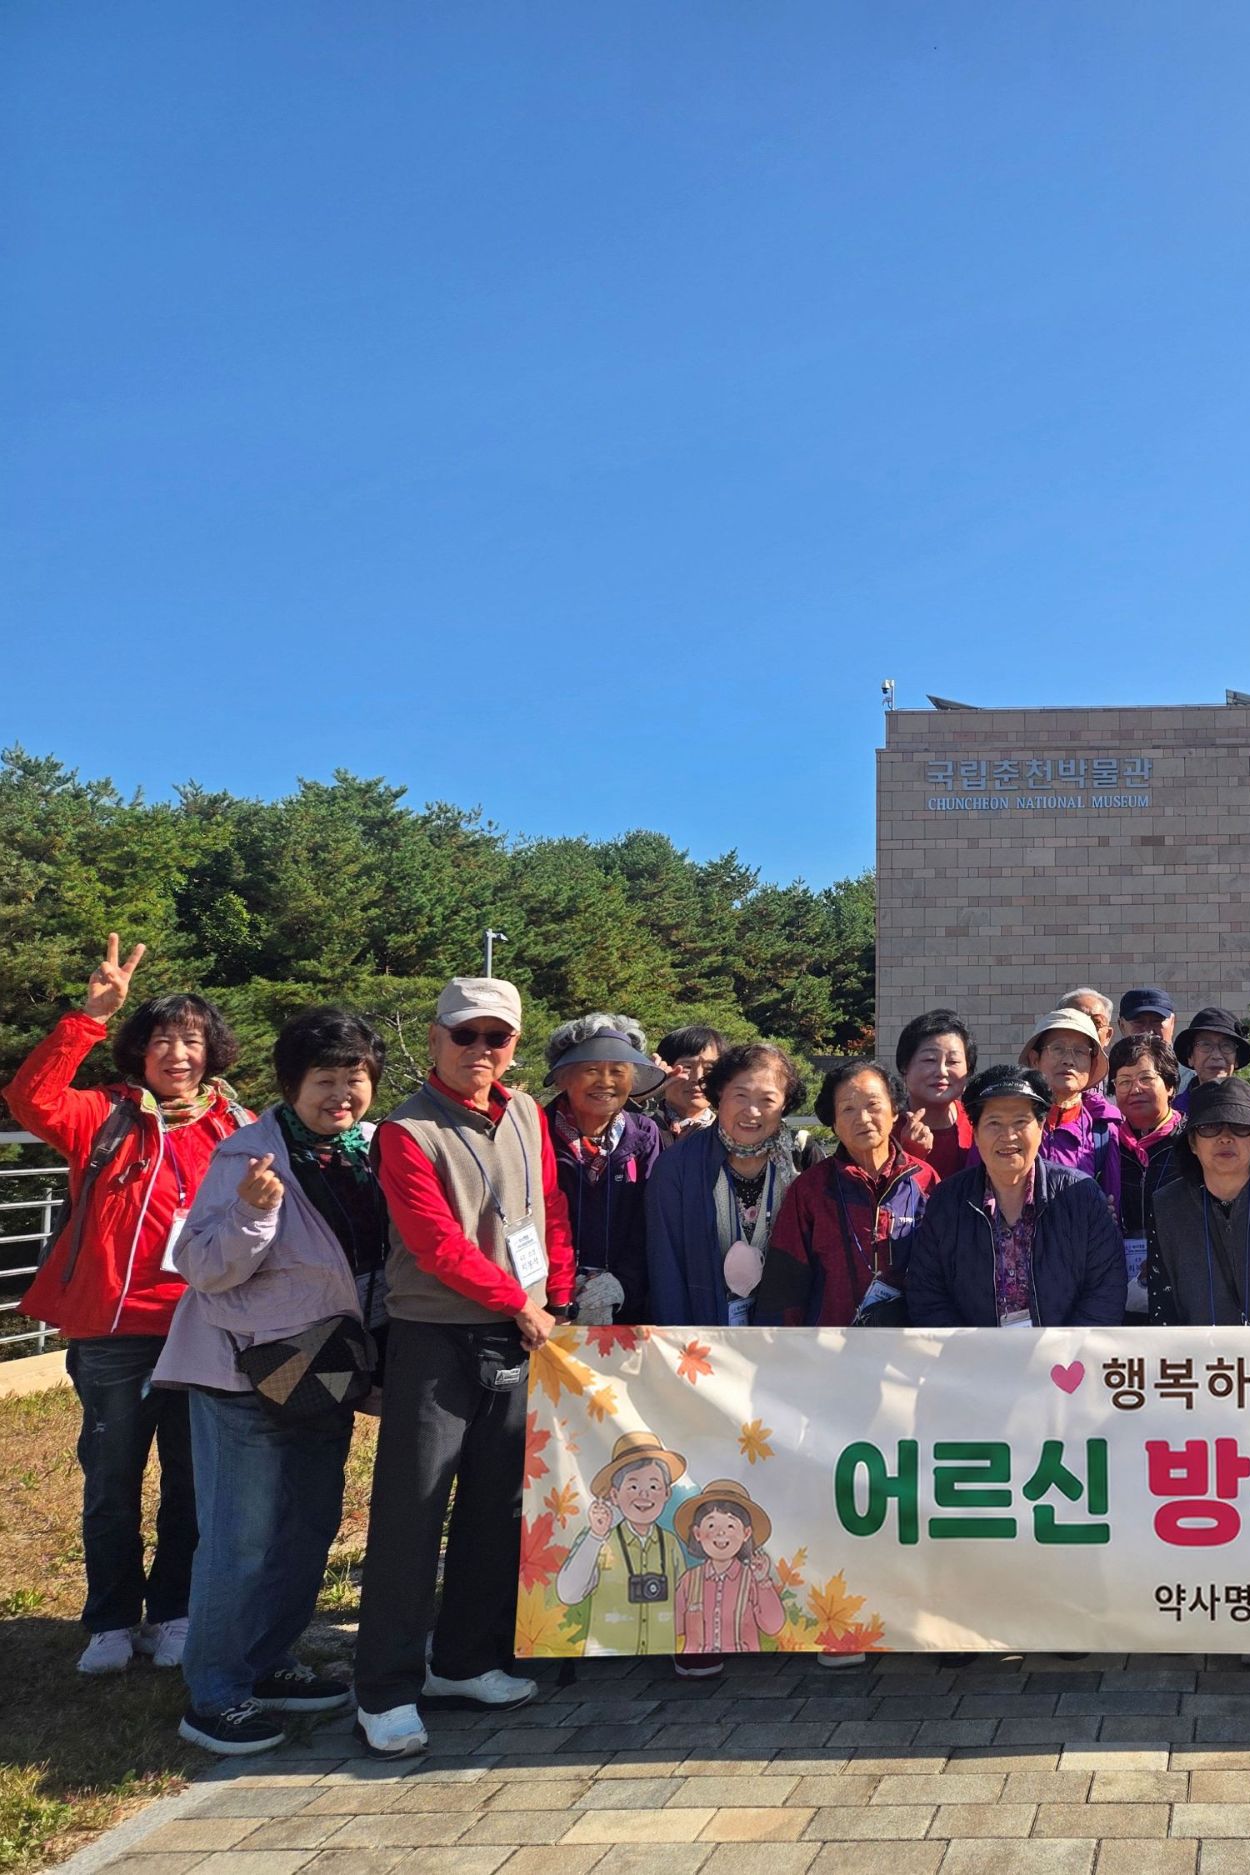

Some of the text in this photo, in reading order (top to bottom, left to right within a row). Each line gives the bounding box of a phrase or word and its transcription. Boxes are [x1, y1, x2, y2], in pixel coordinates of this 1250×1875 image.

[927, 757, 1153, 791] 국립춘천박물관
[928, 795, 1149, 811] CHUNCHEON NATIONAL MUSEUM
[834, 1438, 1111, 1546] 어르신
